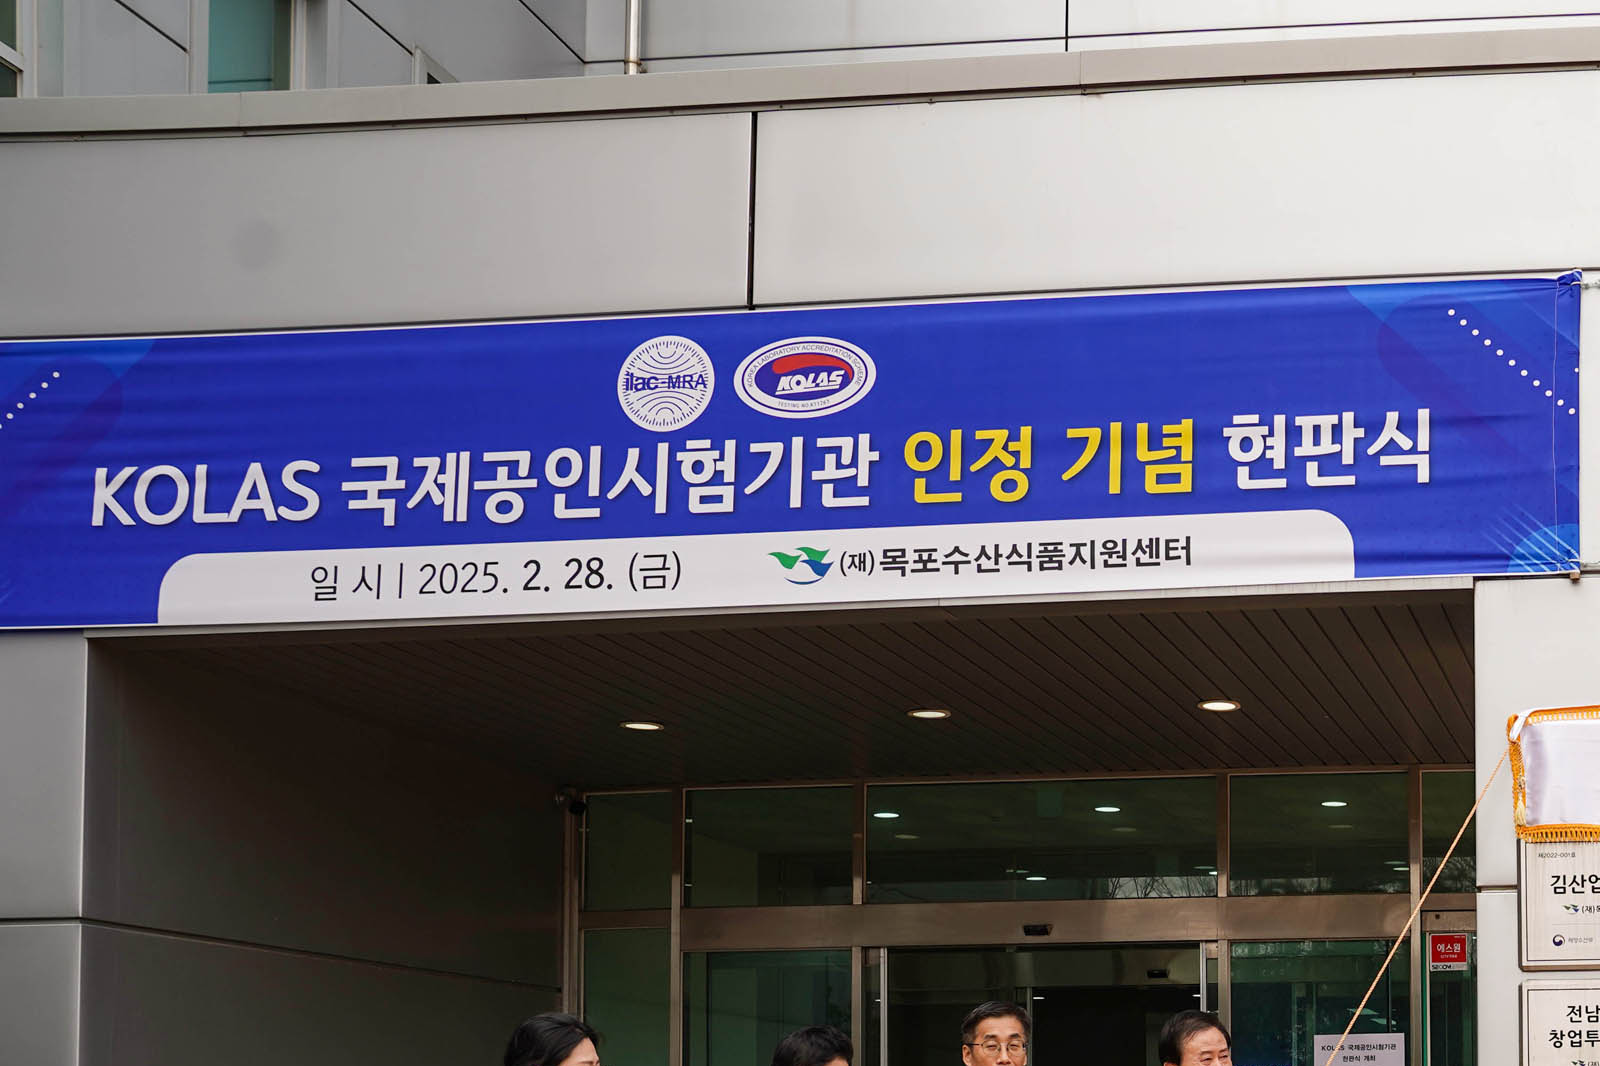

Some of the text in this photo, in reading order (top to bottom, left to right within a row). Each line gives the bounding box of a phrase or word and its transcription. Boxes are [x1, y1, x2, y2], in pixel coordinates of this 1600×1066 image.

[746, 364, 758, 388] KOREA
[757, 345, 801, 368] LABORATORY
[801, 344, 853, 361] ACCREDITATION
[776, 369, 846, 392] KOLAS
[91, 408, 1432, 527] KOLAS 국제공인시험기관 인정 기념 현판식
[418, 561, 509, 595] 2025.
[522, 559, 551, 592] 2.
[564, 557, 613, 591] 28.
[628, 550, 682, 592] (금)
[1436, 943, 1460, 952] 에스원
